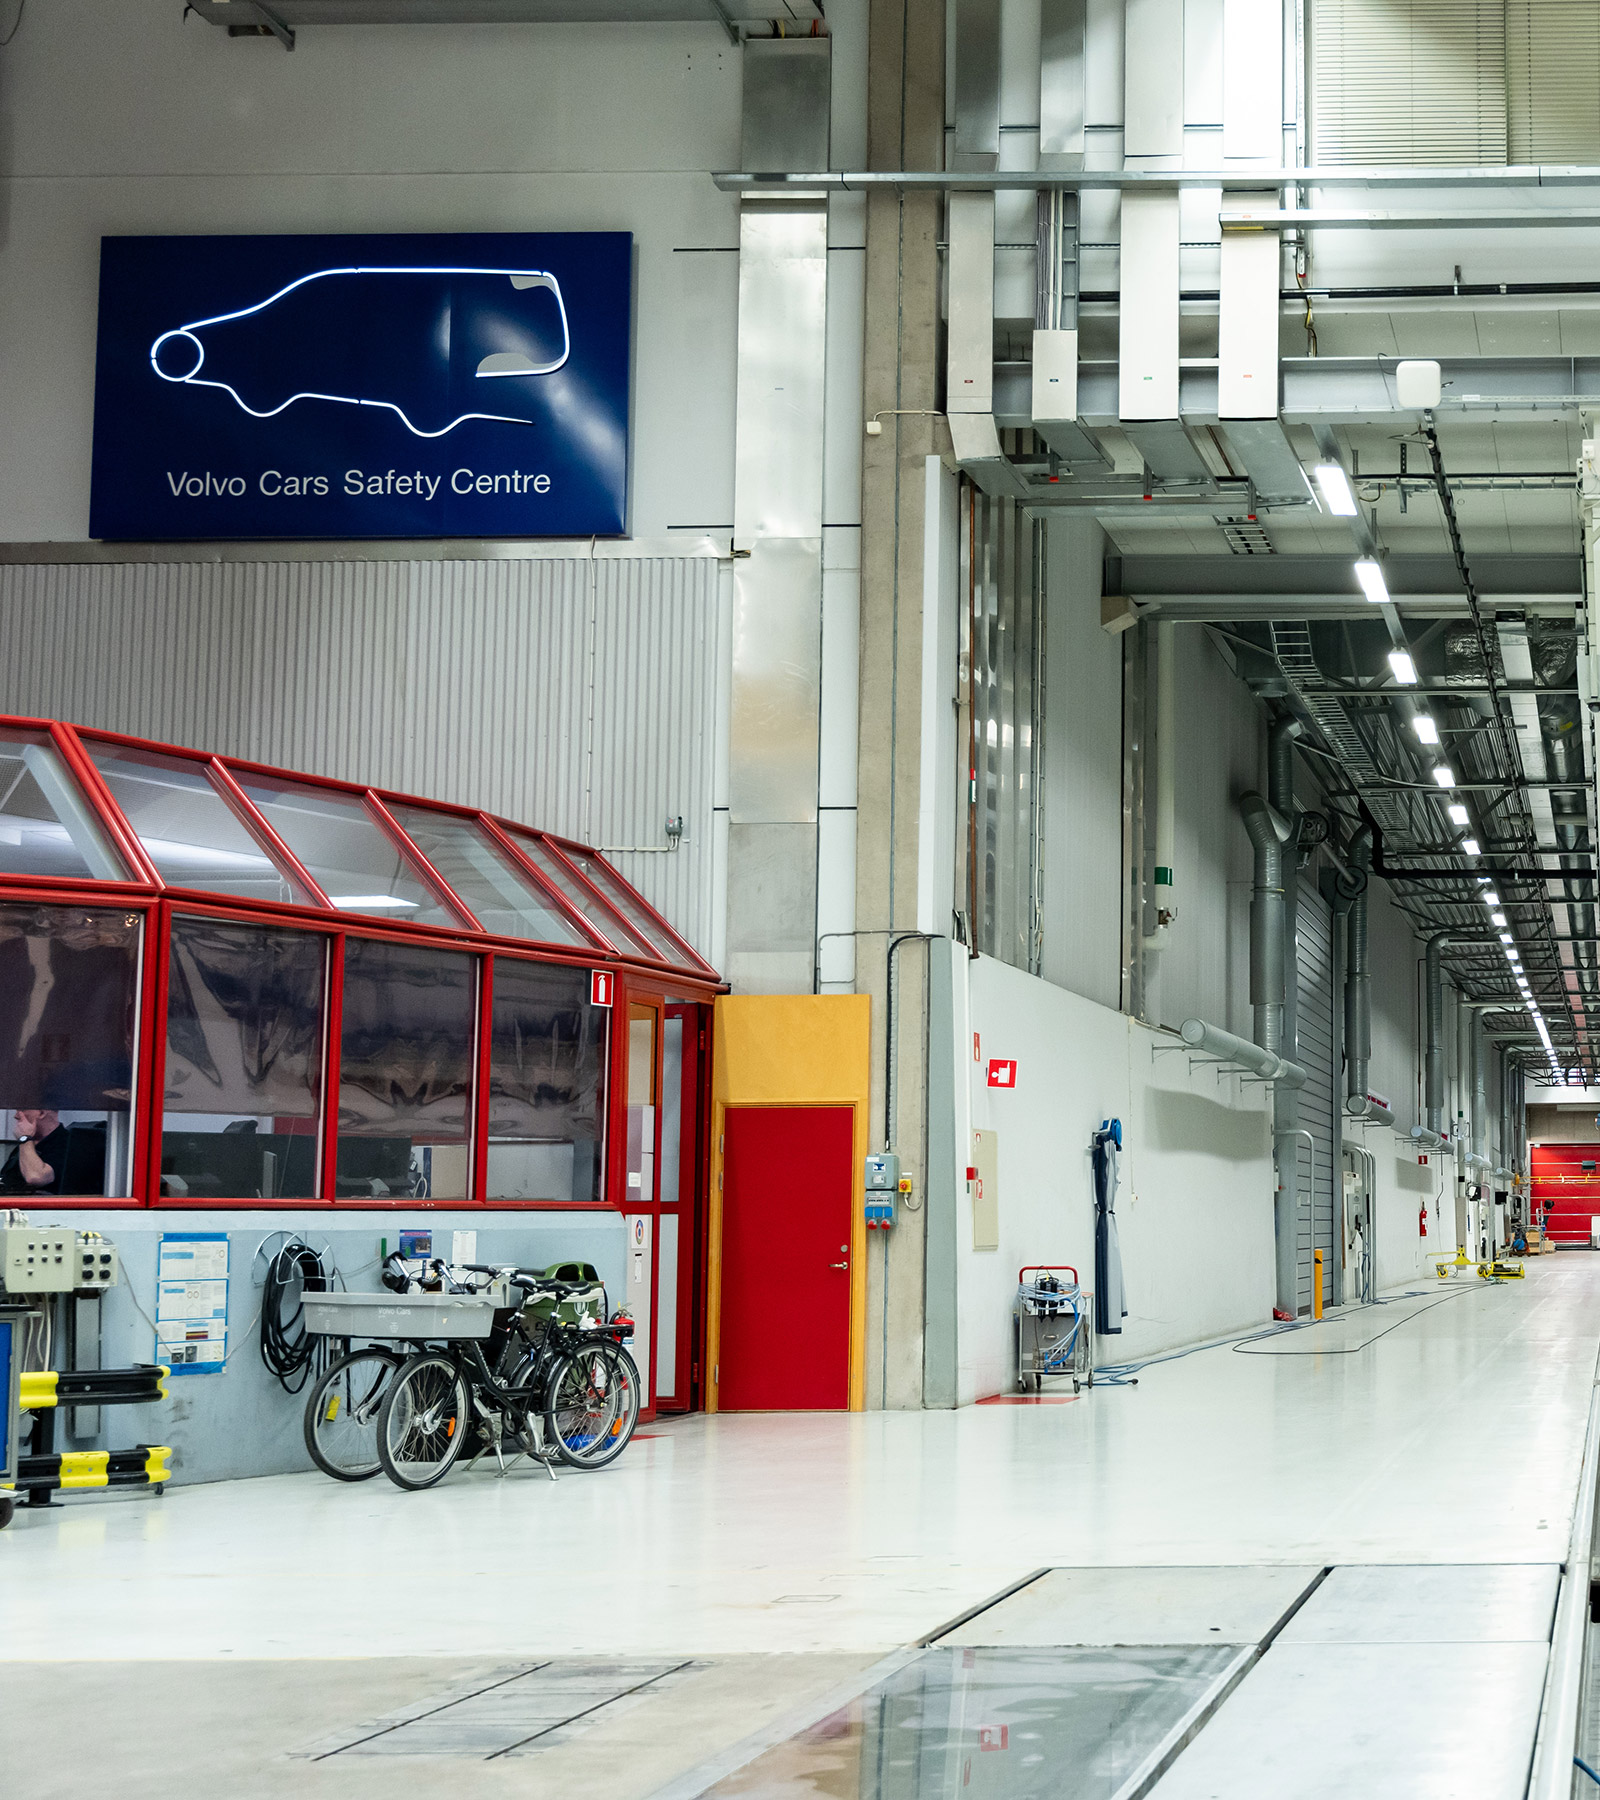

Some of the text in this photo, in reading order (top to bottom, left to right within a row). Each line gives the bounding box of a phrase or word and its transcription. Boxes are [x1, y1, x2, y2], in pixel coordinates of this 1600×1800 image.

[167, 469, 551, 500] Volvo Cars Safety Centre
[378, 1307, 412, 1315] Volvo Cars
